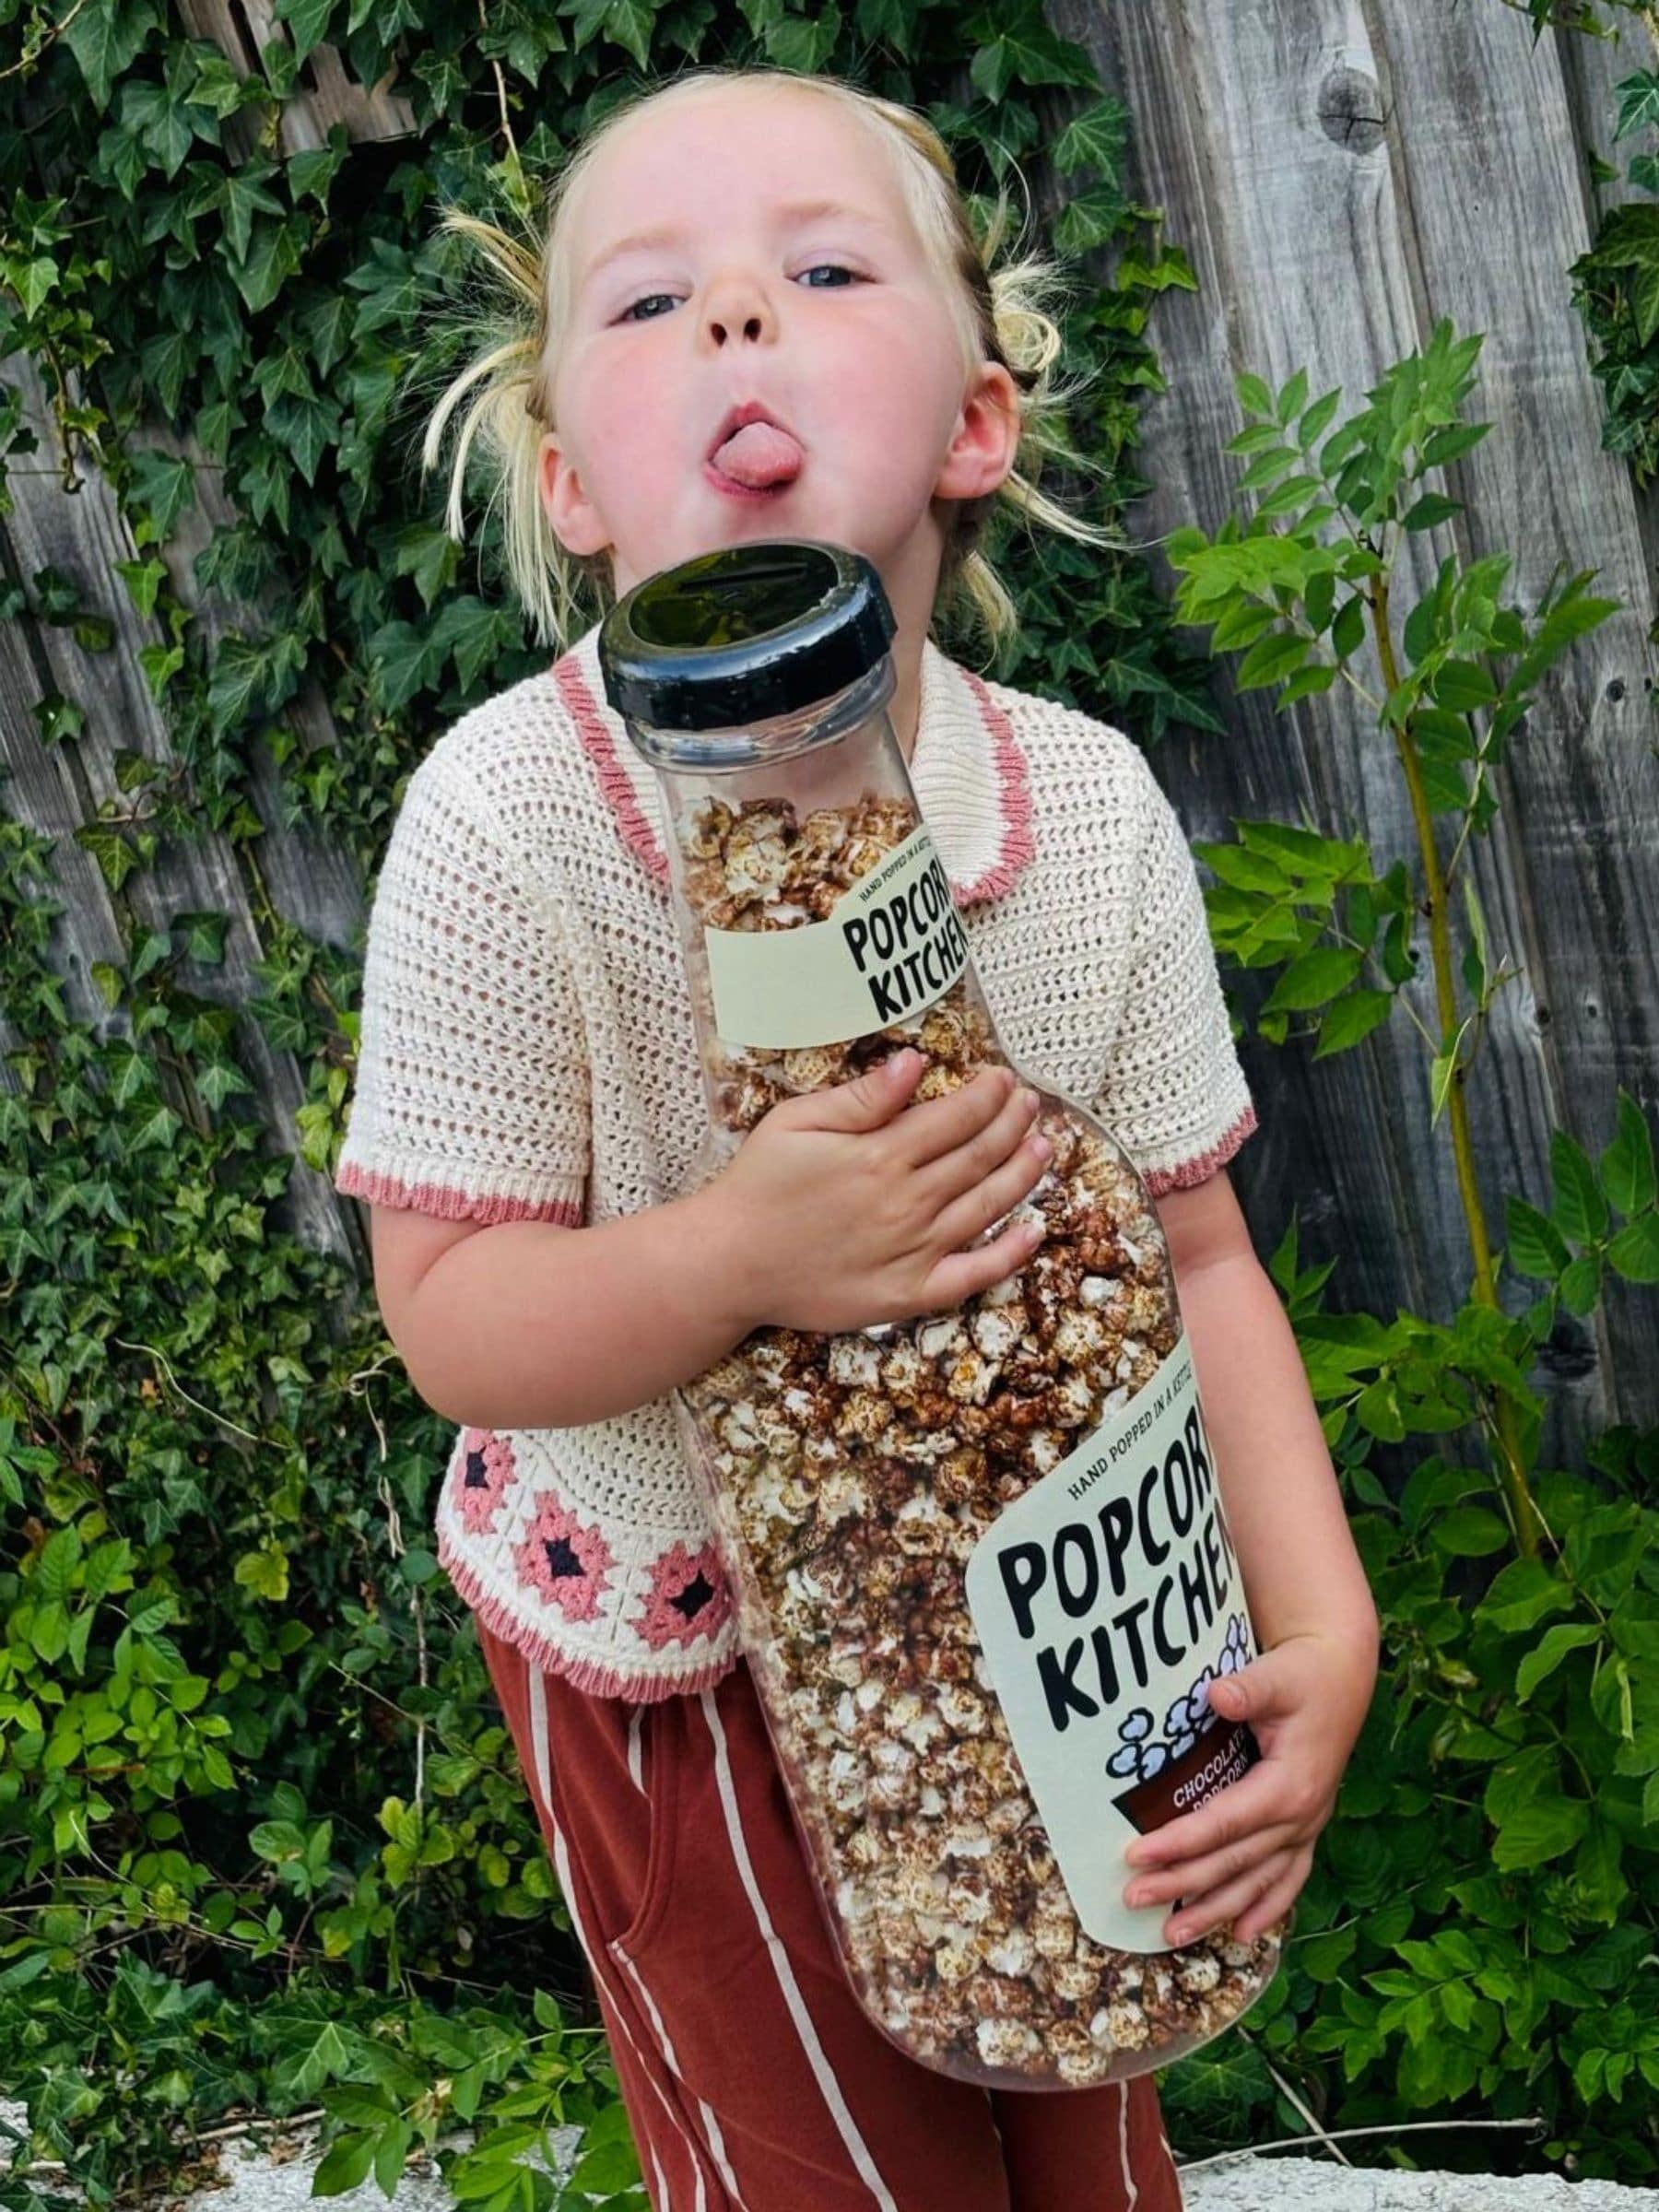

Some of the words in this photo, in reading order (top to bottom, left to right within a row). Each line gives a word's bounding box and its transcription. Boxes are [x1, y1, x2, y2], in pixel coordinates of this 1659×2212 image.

[1066, 1457, 1109, 1500] HAND
[1109, 1411, 1153, 1463] POPPED
[1153, 1394, 1165, 1419] IN
[1165, 1387, 1172, 1407] A
